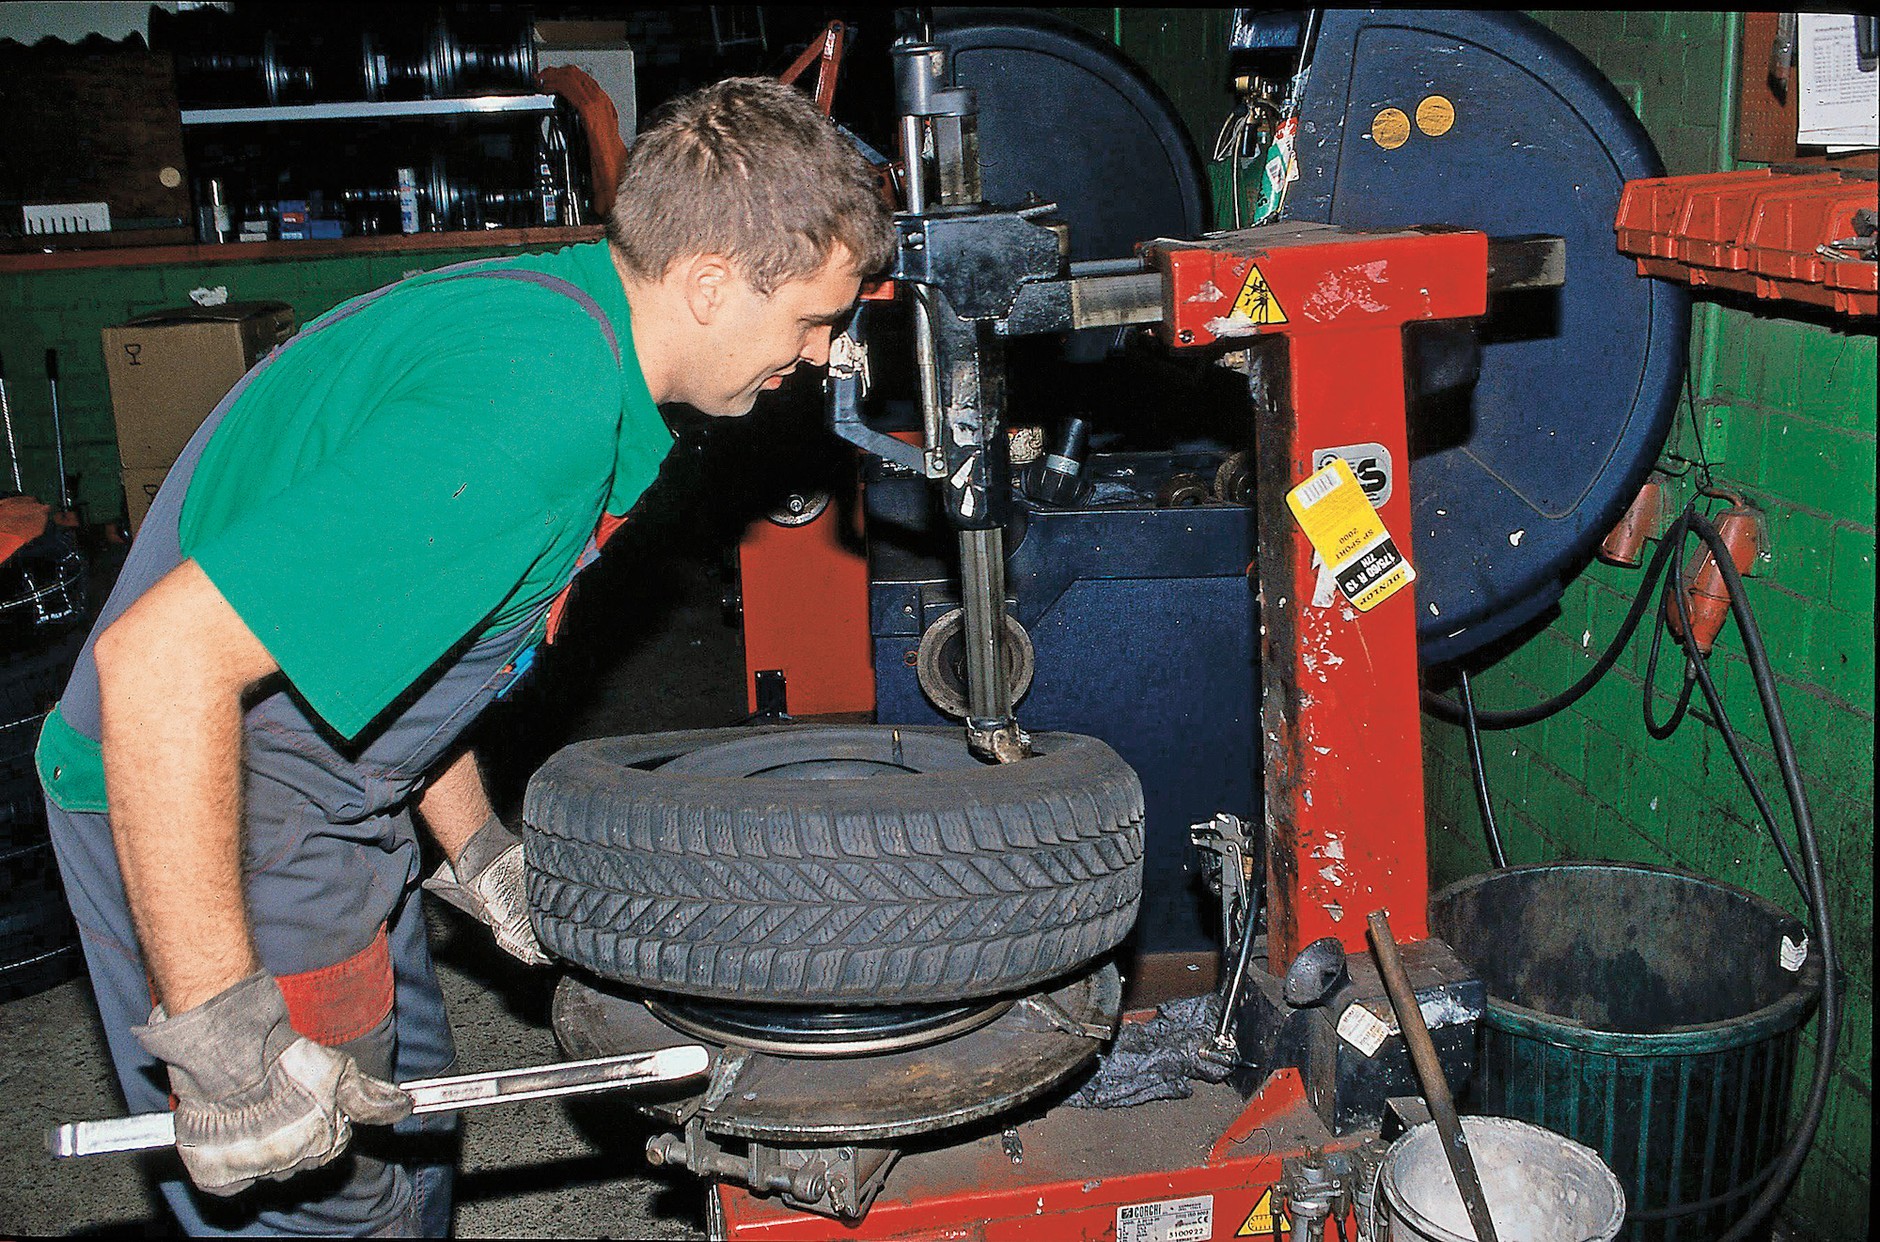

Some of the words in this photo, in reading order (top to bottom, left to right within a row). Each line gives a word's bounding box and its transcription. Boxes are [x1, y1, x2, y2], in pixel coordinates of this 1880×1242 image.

[1339, 527, 1359, 544] 2000
[1363, 529, 1375, 540] SP
[1335, 539, 1361, 560] SPORT
[1365, 552, 1397, 578] 175/60
[1357, 573, 1368, 585] R
[1360, 574, 1402, 605] DUNLOP
